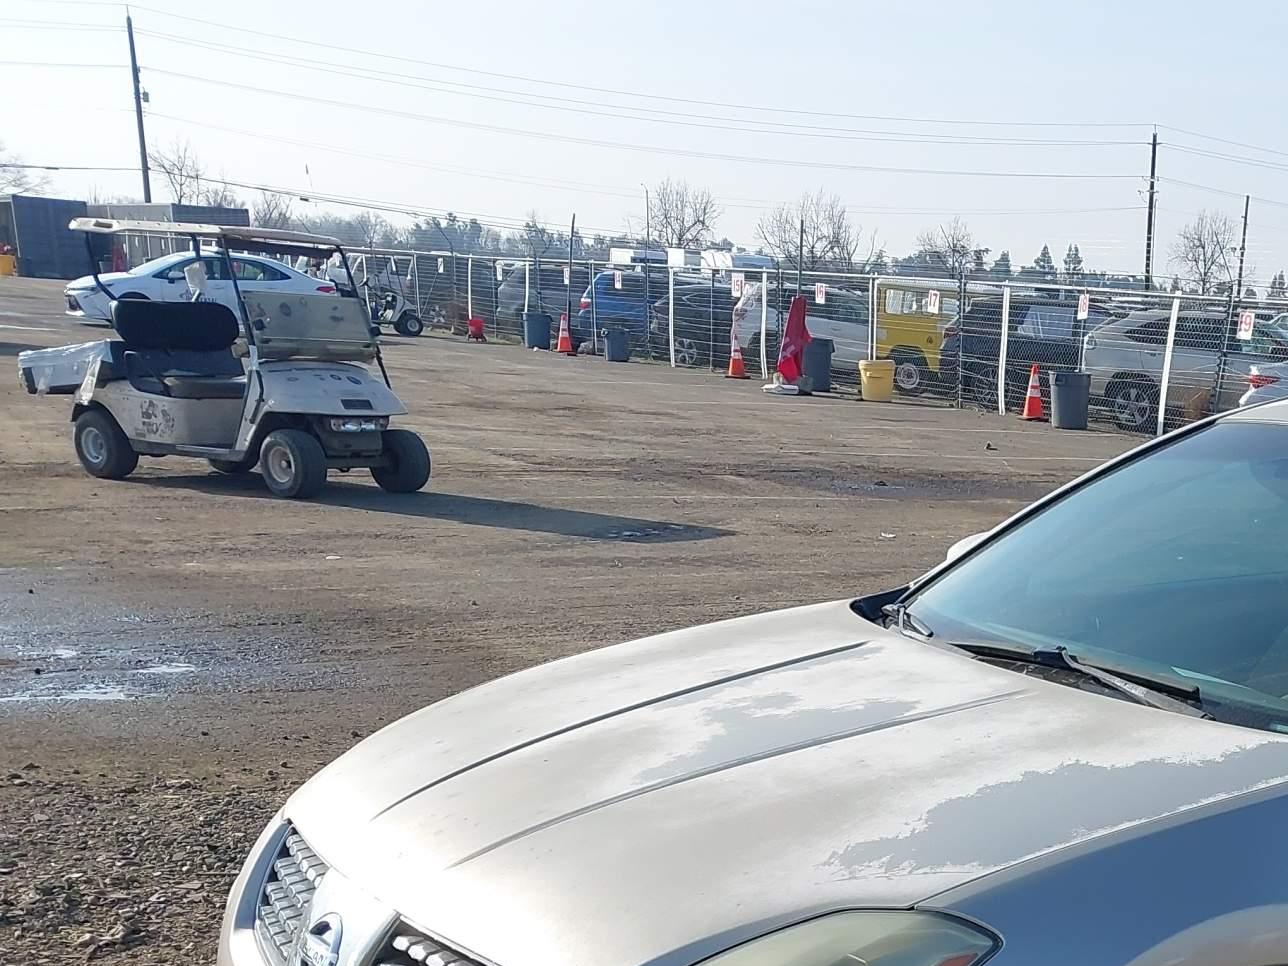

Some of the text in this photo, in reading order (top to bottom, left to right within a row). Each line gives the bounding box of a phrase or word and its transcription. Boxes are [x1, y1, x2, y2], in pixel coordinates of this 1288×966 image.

[815, 283, 825, 298] 16
[929, 291, 938, 307] 17
[1079, 295, 1089, 313] 18
[1239, 314, 1251, 332] 19
